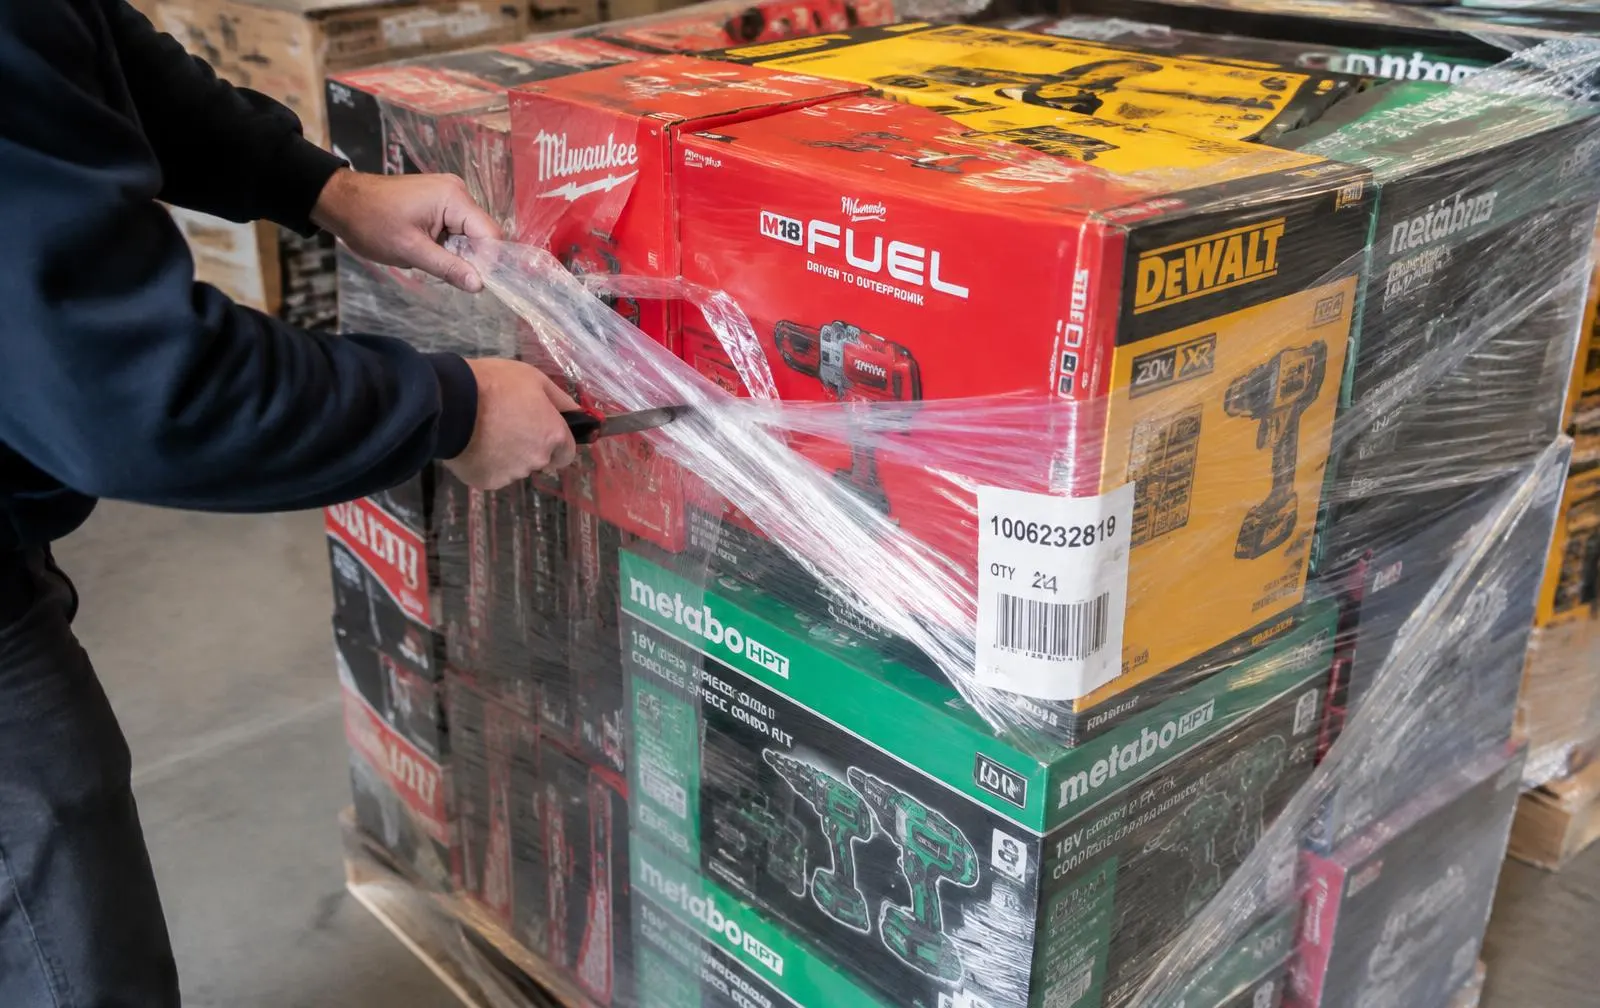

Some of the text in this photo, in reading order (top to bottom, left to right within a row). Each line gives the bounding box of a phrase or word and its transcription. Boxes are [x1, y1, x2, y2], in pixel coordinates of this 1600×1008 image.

[533, 129, 638, 182] Milwaukee
[762, 212, 969, 299] M18 FUEL
[807, 260, 839, 280] DRIVEN
[842, 271, 854, 284] TO
[1136, 357, 1175, 385] 20V
[991, 515, 1116, 548] 1006232819
[990, 562, 1016, 581] QTY
[629, 576, 744, 654] metabo
[745, 635, 790, 680] HPT
[631, 630, 656, 654] 18V
[1057, 721, 1177, 809] metabo
[1055, 827, 1084, 859] 18V
[639, 858, 743, 946] metabo
